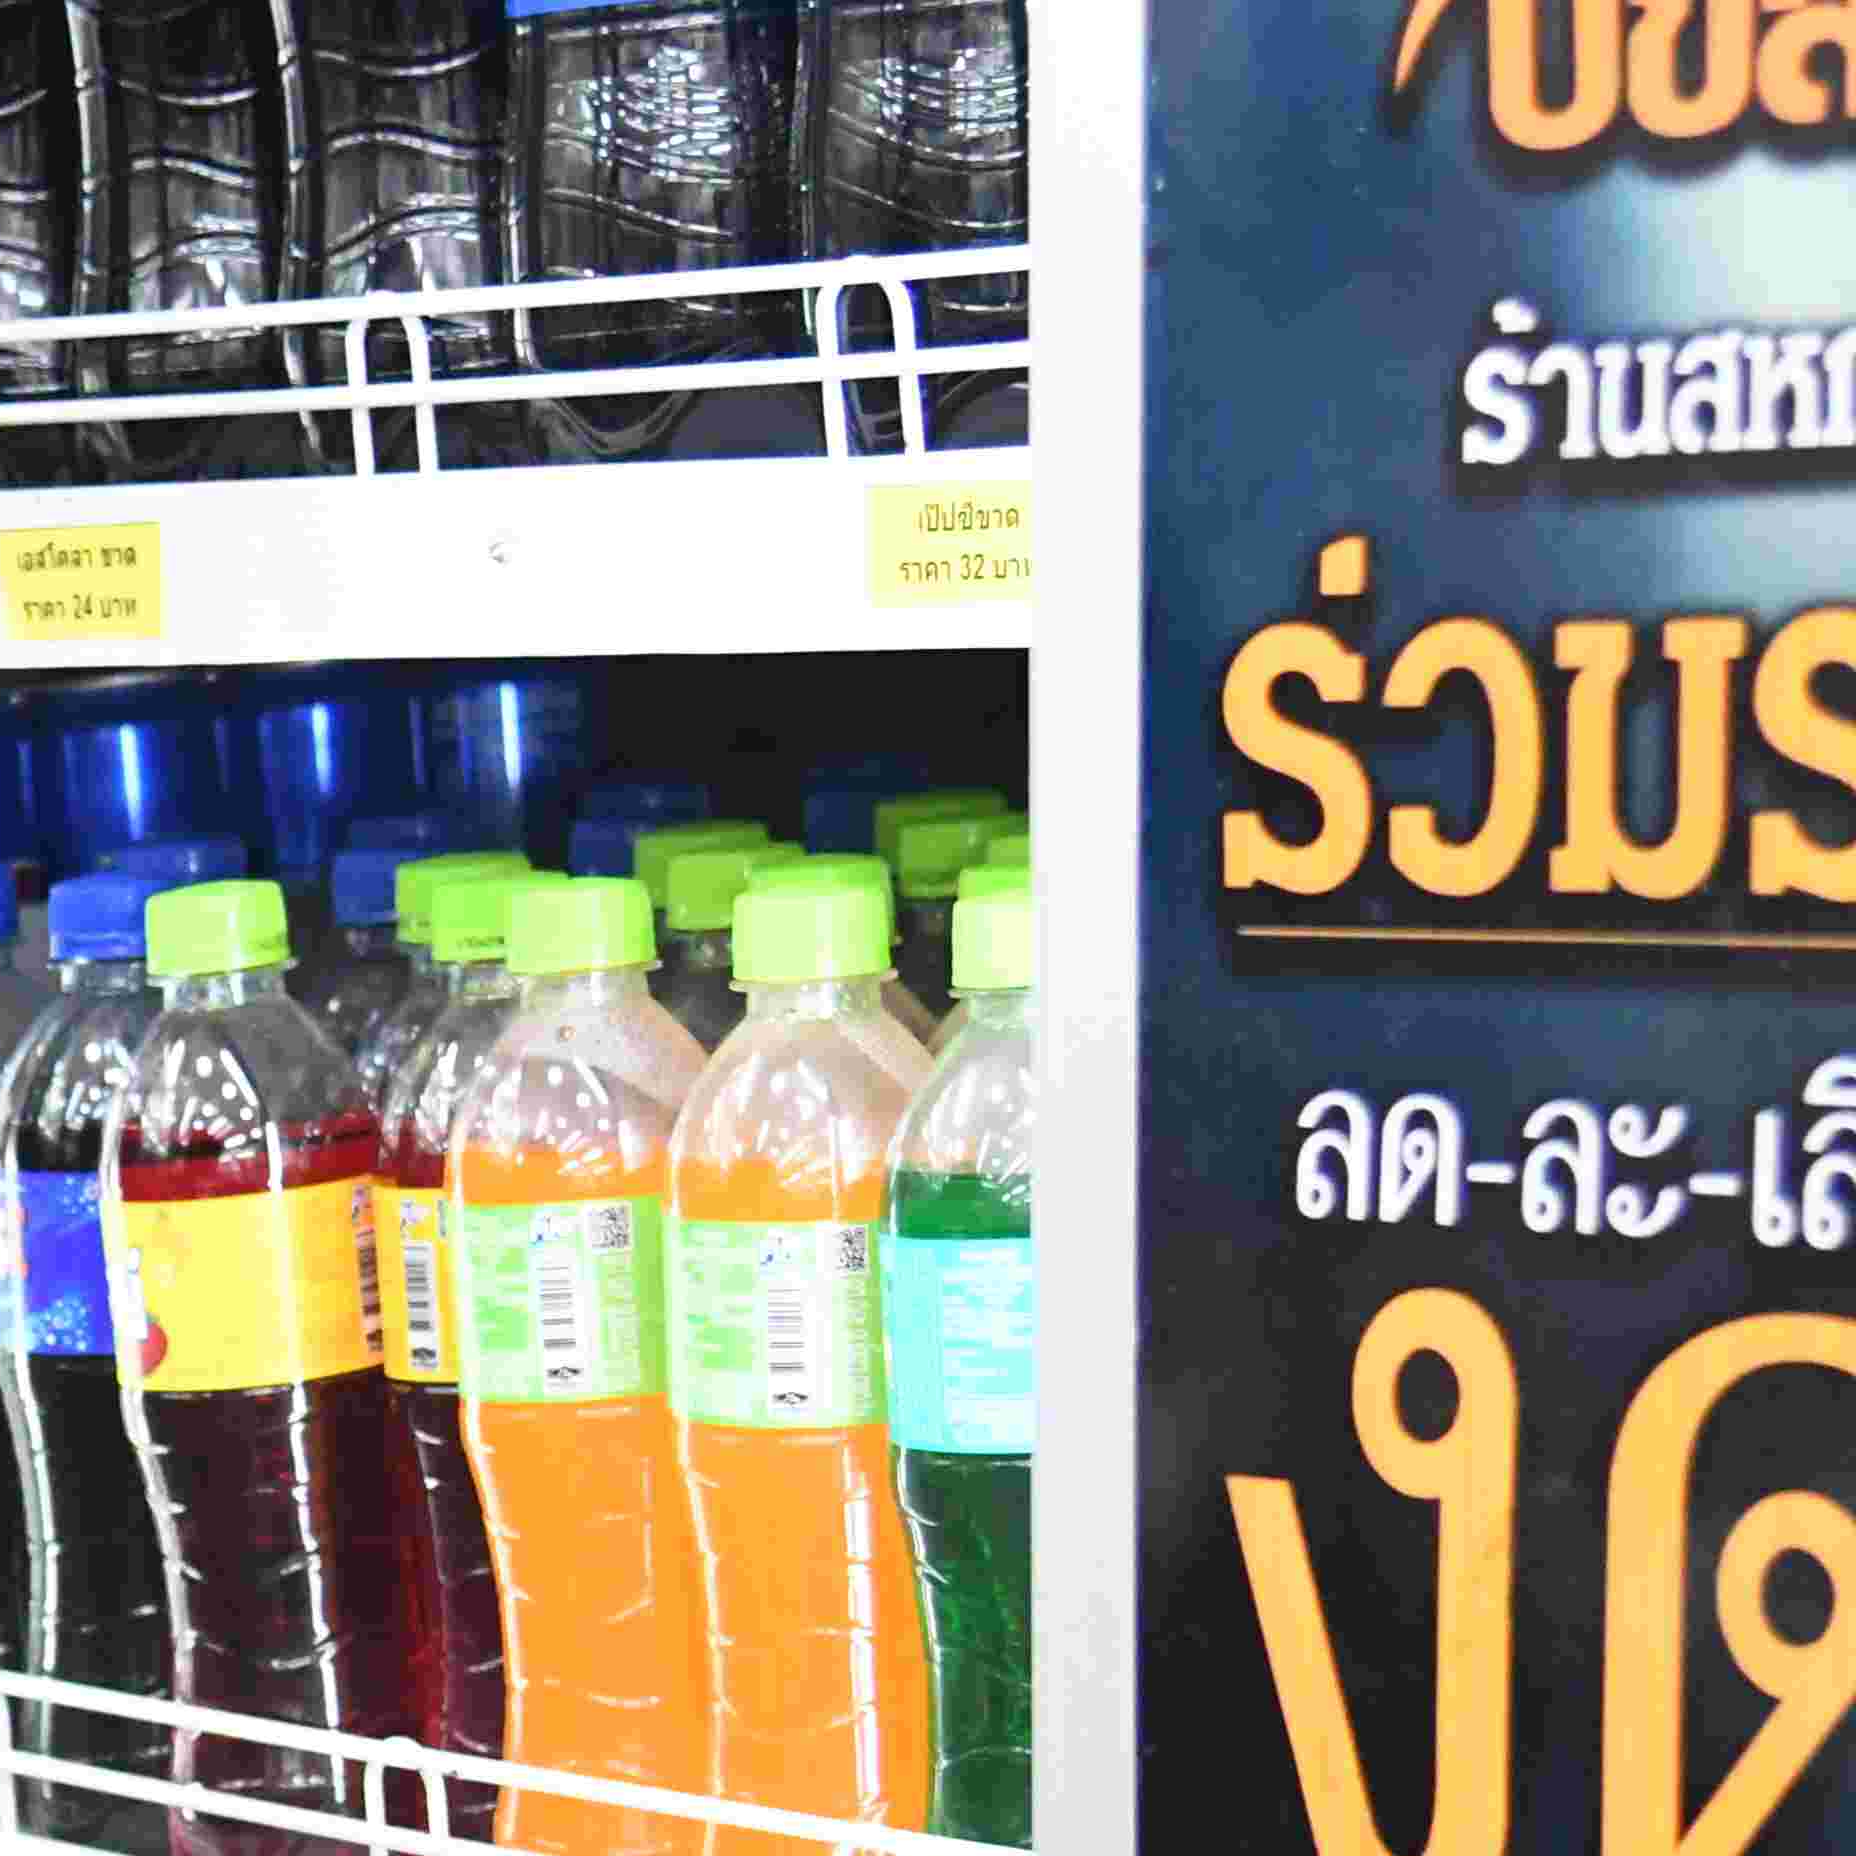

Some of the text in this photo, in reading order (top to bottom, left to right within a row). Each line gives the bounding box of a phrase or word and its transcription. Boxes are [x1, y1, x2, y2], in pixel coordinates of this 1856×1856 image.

[899, 560, 952, 583] ราคา
[960, 554, 985, 580] 32
[72, 594, 93, 619] 24
